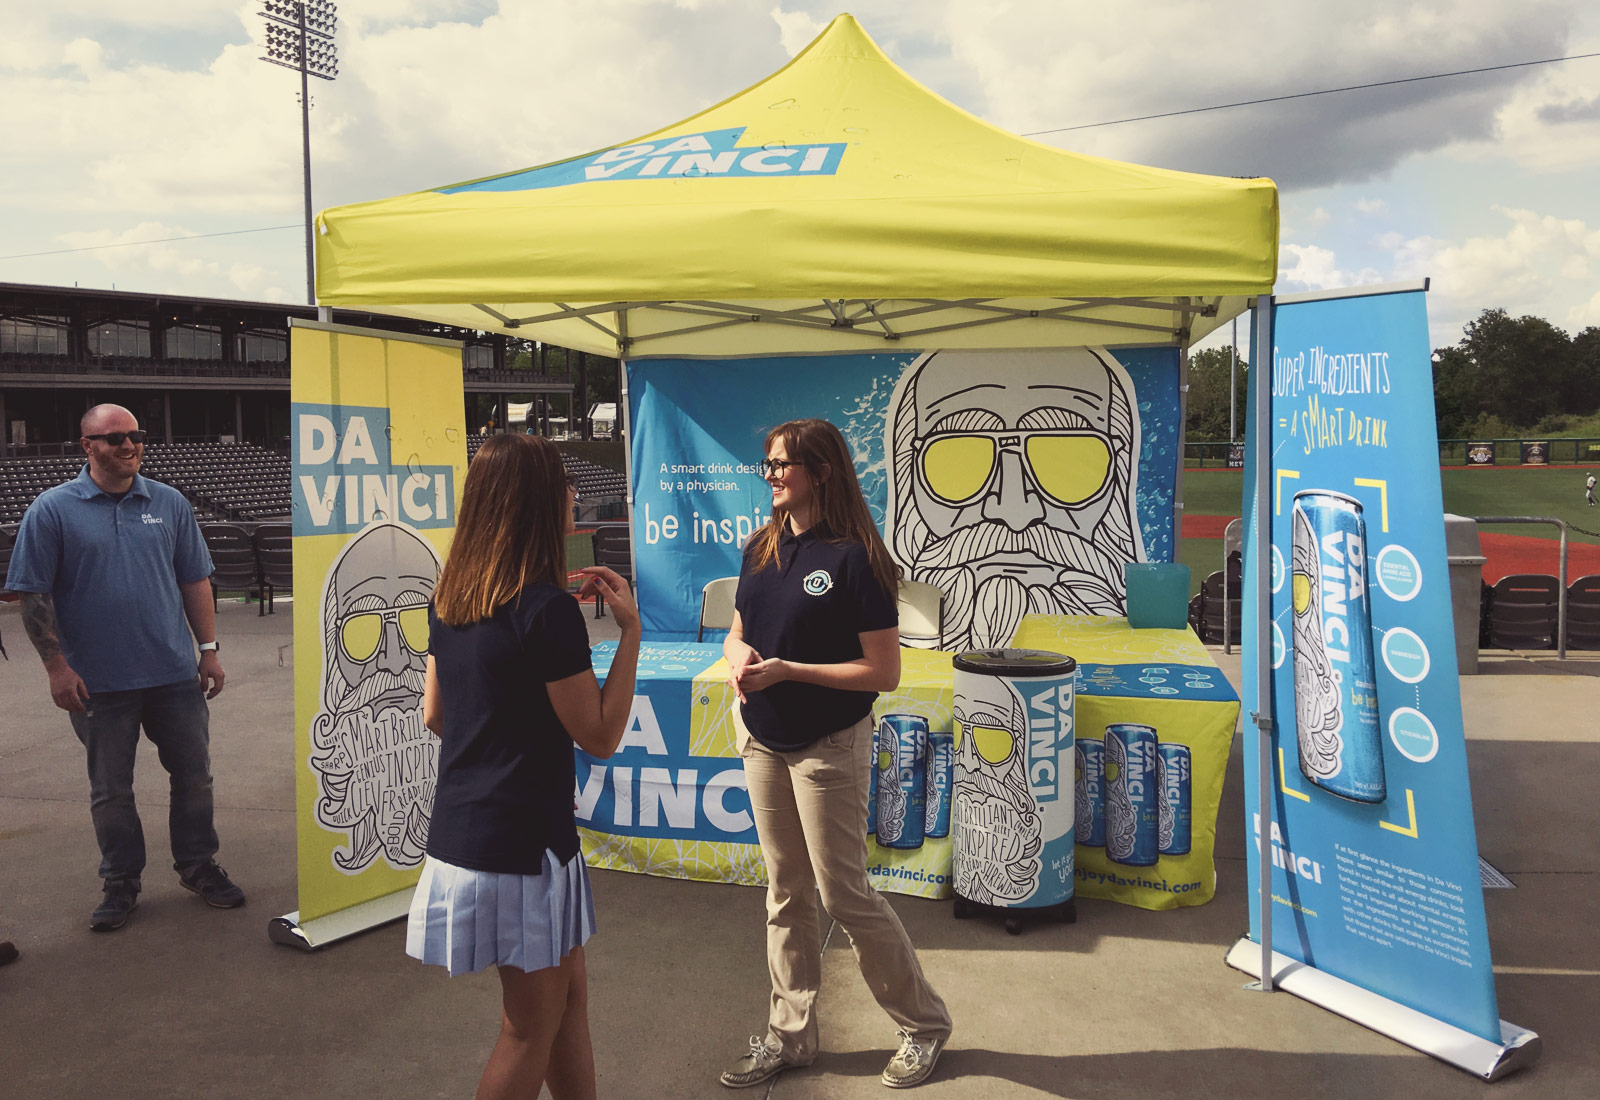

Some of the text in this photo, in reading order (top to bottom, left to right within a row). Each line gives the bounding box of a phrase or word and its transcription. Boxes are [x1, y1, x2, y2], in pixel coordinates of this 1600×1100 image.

[583, 147, 830, 181] VINCI
[594, 134, 713, 164] DA
[1272, 346, 1390, 397] SUPER INGREDIENTS
[299, 414, 379, 465] DA
[1302, 393, 1344, 455] SMART
[1348, 410, 1387, 448] DRINK
[660, 462, 768, 476] A smart drink desig
[660, 479, 740, 493] by a physician.
[299, 472, 447, 527] VINCI
[644, 502, 772, 550] be inspir
[1346, 532, 1364, 601] DA
[1321, 530, 1350, 663] VINCI
[600, 694, 669, 756] A
[1058, 683, 1072, 741] DA
[321, 751, 345, 770] SHARP
[341, 713, 388, 769] SMART
[900, 730, 915, 787] VINCI
[916, 730, 927, 760] DA
[1031, 686, 1056, 796] VINCI
[1145, 741, 1156, 773] DA
[354, 754, 386, 783] GENIUS
[386, 742, 442, 788] INSPIR
[935, 743, 947, 789] VINCI
[1086, 751, 1099, 798] VINCI
[1128, 740, 1144, 802] VINCI
[1167, 756, 1180, 804] VINCI
[1180, 757, 1190, 782] DA
[333, 807, 353, 824] QUICK
[574, 764, 754, 832] VINC
[964, 798, 1015, 829] BRILLIANT
[387, 810, 406, 845] BOLD
[960, 825, 1020, 864] INSPIRED
[980, 861, 1013, 895] SHREWD
